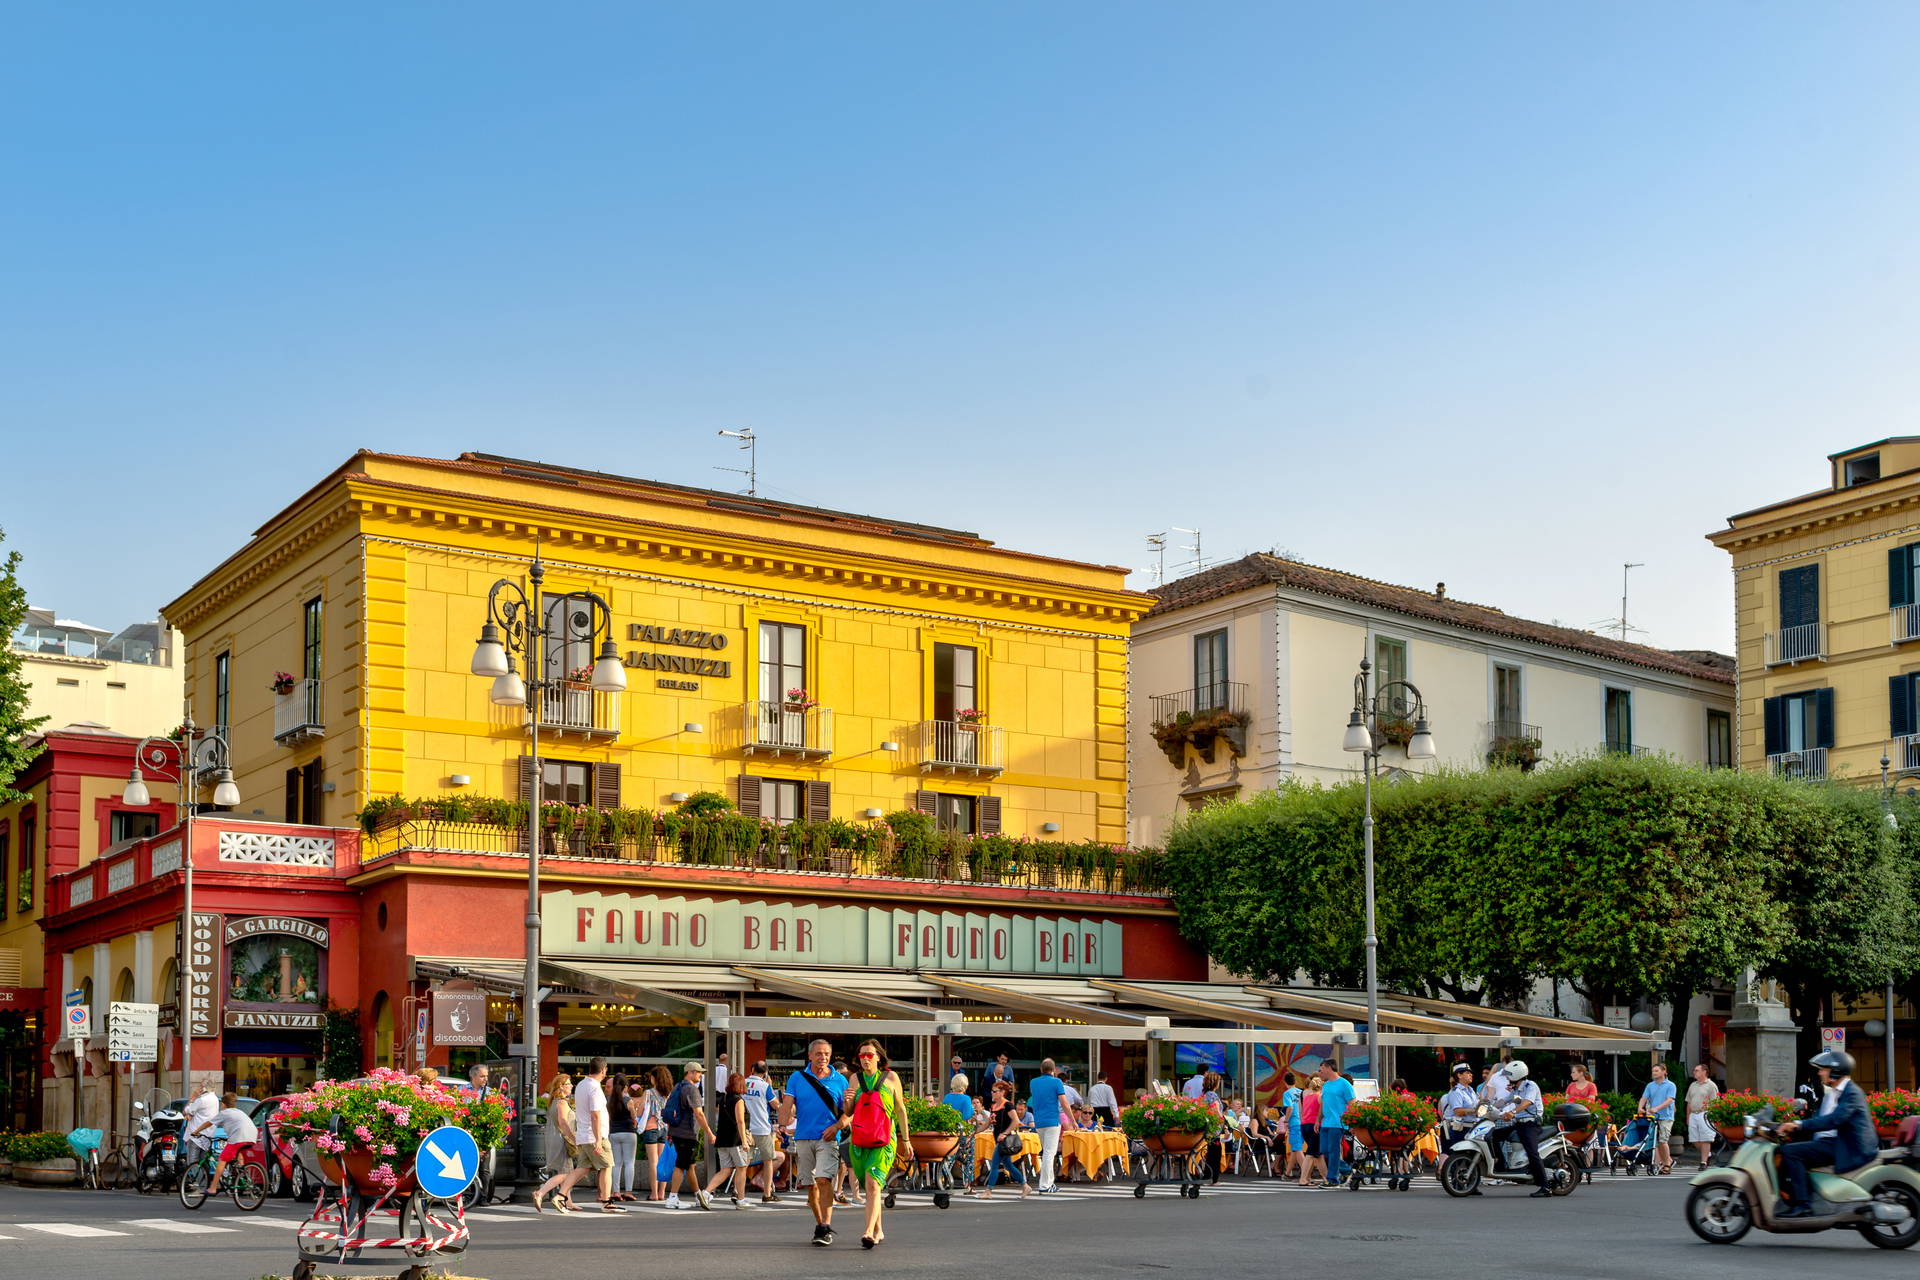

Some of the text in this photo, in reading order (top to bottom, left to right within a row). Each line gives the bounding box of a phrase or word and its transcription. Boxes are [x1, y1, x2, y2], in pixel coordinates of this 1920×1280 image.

[627, 623, 728, 650] PALAZZO
[624, 650, 732, 678] JANNUZZI
[656, 678, 699, 691] RELAIS
[226, 918, 328, 942] A. GARGIULO
[576, 907, 813, 952] FAUNO BAR
[898, 923, 1097, 964] FAUNO BAR
[191, 916, 214, 1034] WOOD WORKS
[234, 1013, 318, 1027] JANNUZZI
[434, 1033, 485, 1044] discoteque
